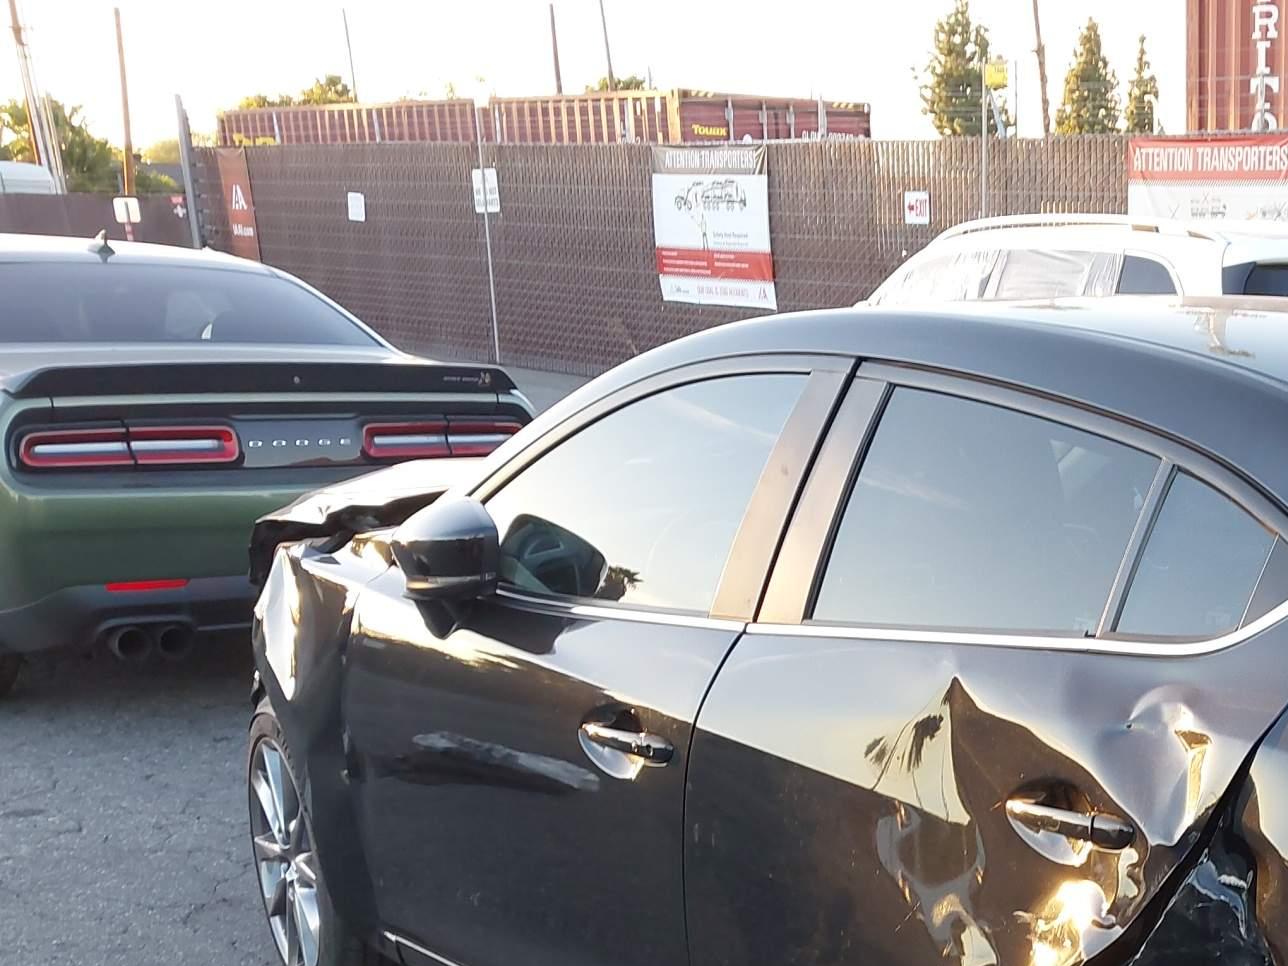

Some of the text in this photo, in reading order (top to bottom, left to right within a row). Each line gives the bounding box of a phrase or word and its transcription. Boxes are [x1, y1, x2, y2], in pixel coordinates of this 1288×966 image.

[664, 150, 700, 169] ATTENTION
[1134, 147, 1193, 172] ATTENTION
[915, 199, 927, 217] EXIT
